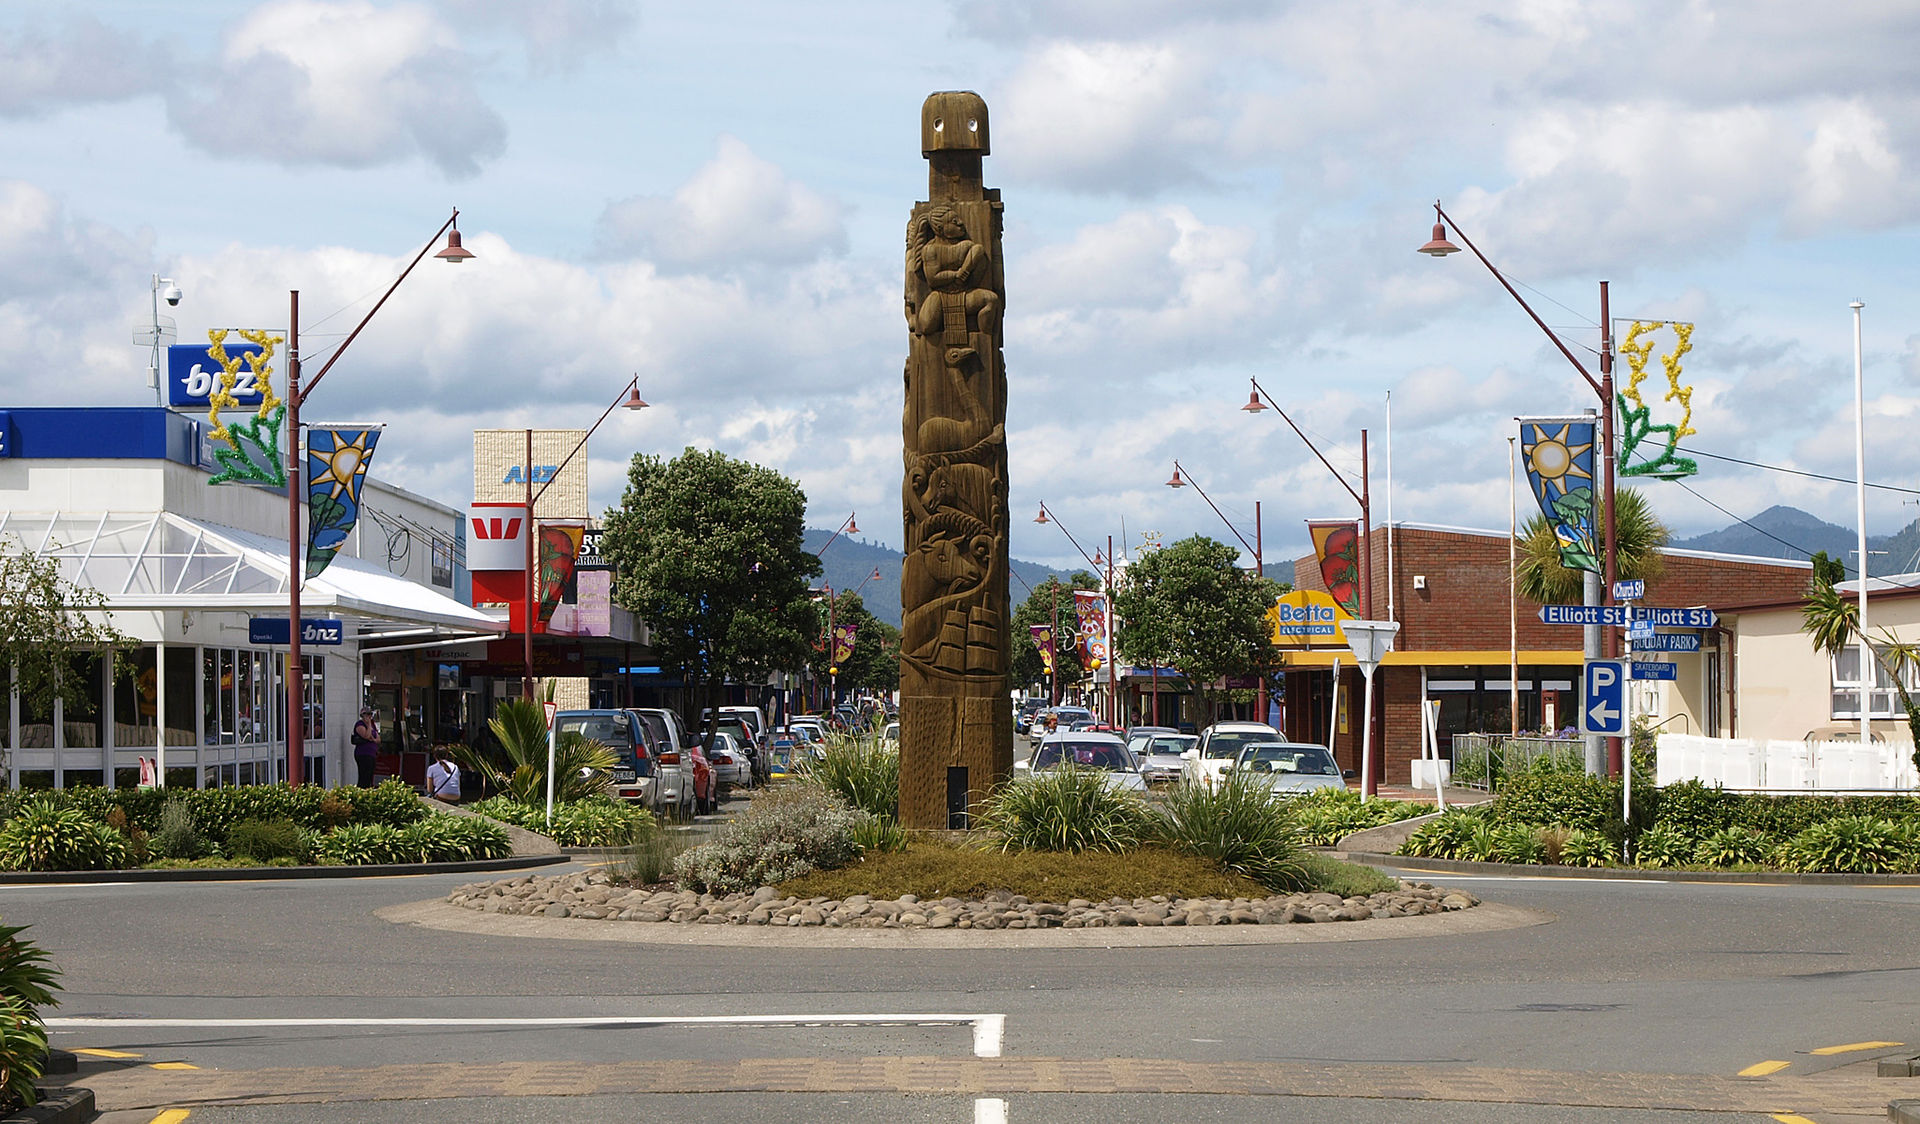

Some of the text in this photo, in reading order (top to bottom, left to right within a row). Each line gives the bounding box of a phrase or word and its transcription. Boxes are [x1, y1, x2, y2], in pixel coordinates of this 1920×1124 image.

[503, 466, 557, 483] ANZ
[1616, 581, 1642, 598] Church St
[1280, 604, 1335, 622] Betta
[1549, 607, 1621, 624] Elliott St
[1636, 609, 1685, 625] Elliott
[1689, 610, 1708, 626] St
[302, 625, 338, 640] bnz
[1670, 635, 1692, 650] PARK
[426, 650, 470, 658] Westpac
[1635, 663, 1670, 672] SKATEBOARD
[1645, 671, 1659, 679] PARK
[1592, 667, 1616, 696] P
